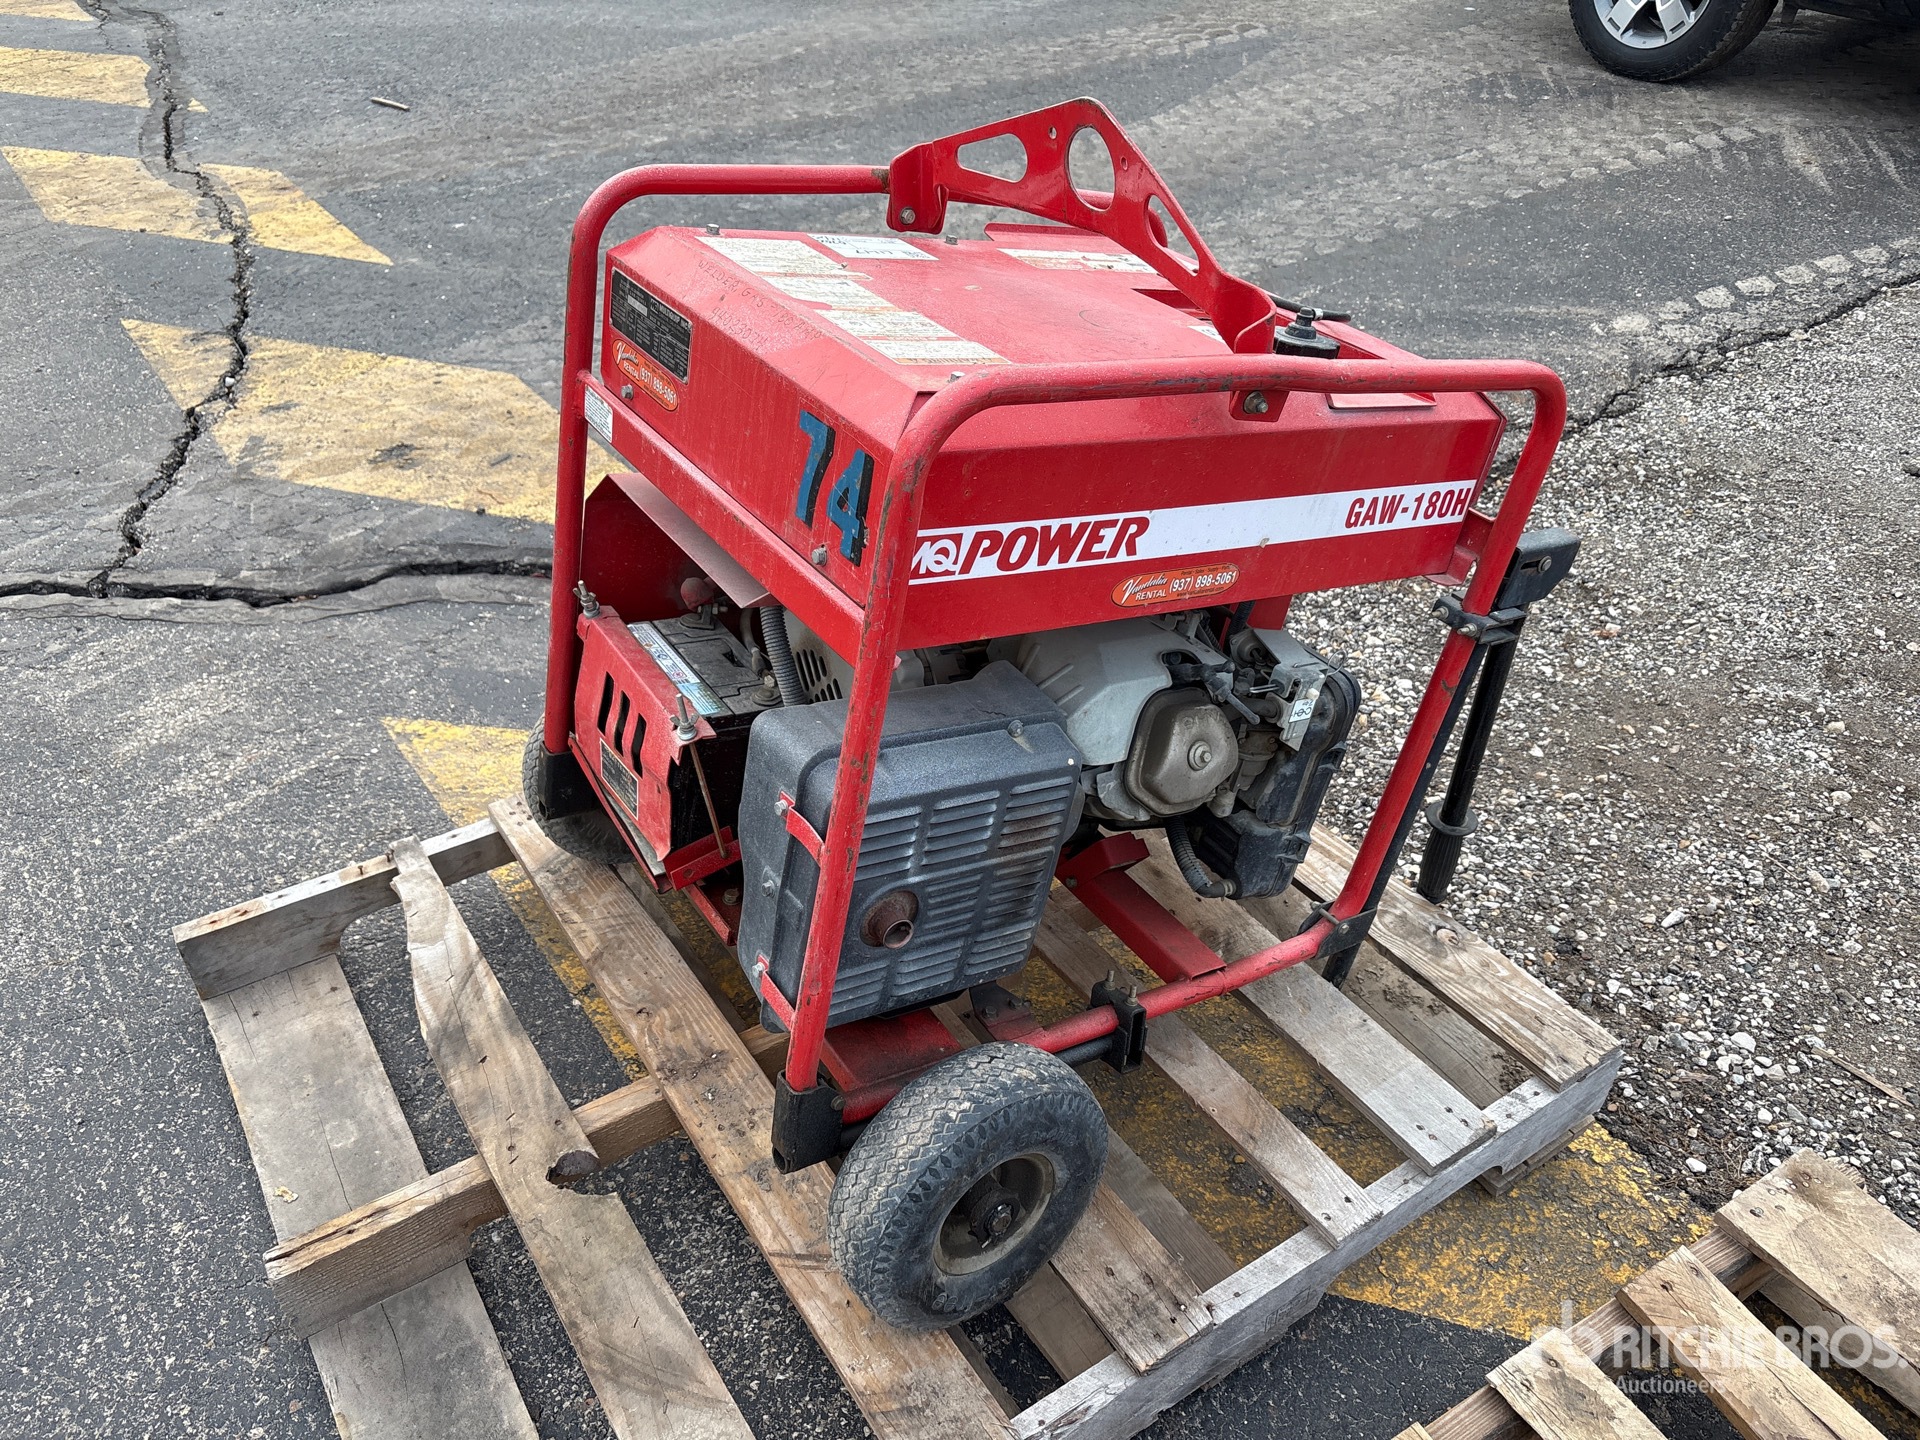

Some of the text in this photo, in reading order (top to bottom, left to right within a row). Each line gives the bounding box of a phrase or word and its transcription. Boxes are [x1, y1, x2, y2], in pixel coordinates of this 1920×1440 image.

[796, 410, 875, 567] 74
[1344, 488, 1471, 529] GAW-180H
[958, 516, 1150, 575] POWER
[1121, 572, 1169, 604] Vandalia
[1135, 570, 1238, 601] RENTAL (937) 898-5061
